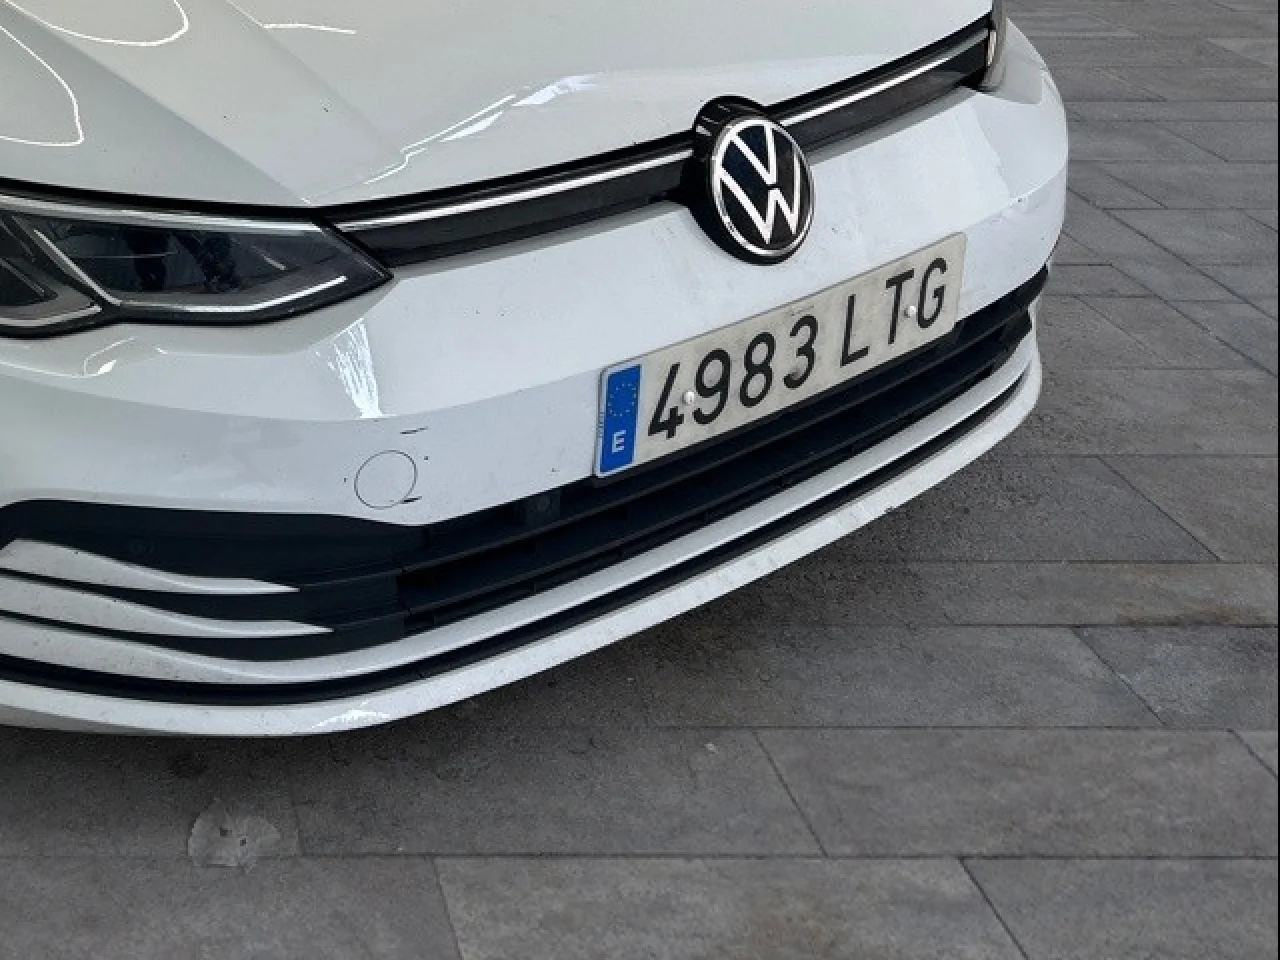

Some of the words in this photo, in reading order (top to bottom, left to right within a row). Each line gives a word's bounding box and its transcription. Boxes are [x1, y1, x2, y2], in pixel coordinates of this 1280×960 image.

[718, 122, 809, 246] VW
[648, 316, 818, 439] 4983
[840, 257, 947, 366] LTG
[612, 430, 626, 452] E
